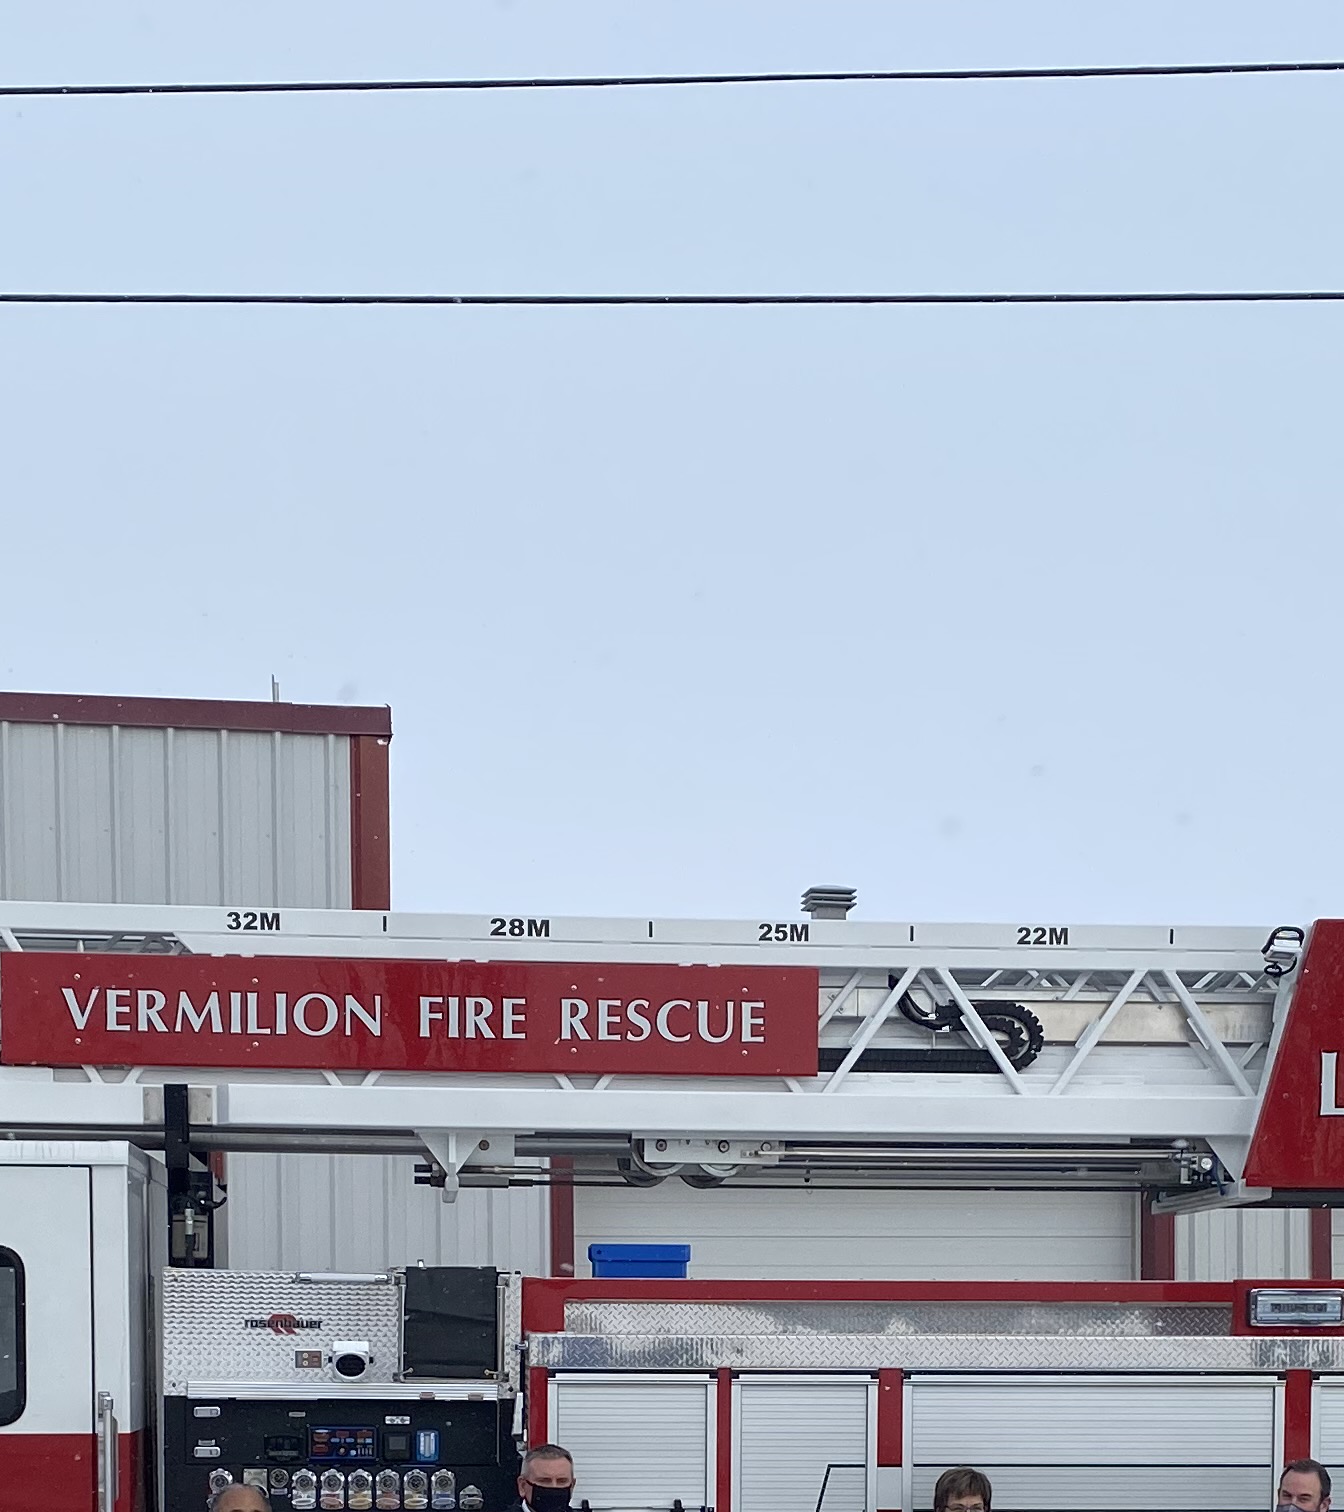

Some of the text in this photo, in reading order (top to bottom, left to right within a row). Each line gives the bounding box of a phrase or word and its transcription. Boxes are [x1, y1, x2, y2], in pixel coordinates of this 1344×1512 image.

[226, 911, 281, 930] 32M
[489, 917, 550, 937] 28M
[758, 923, 809, 942] 25M
[1016, 927, 1069, 945] 22M
[61, 986, 765, 1043] VERMILION FIRE RESCUE
[244, 1317, 323, 1329] rosenbauer
